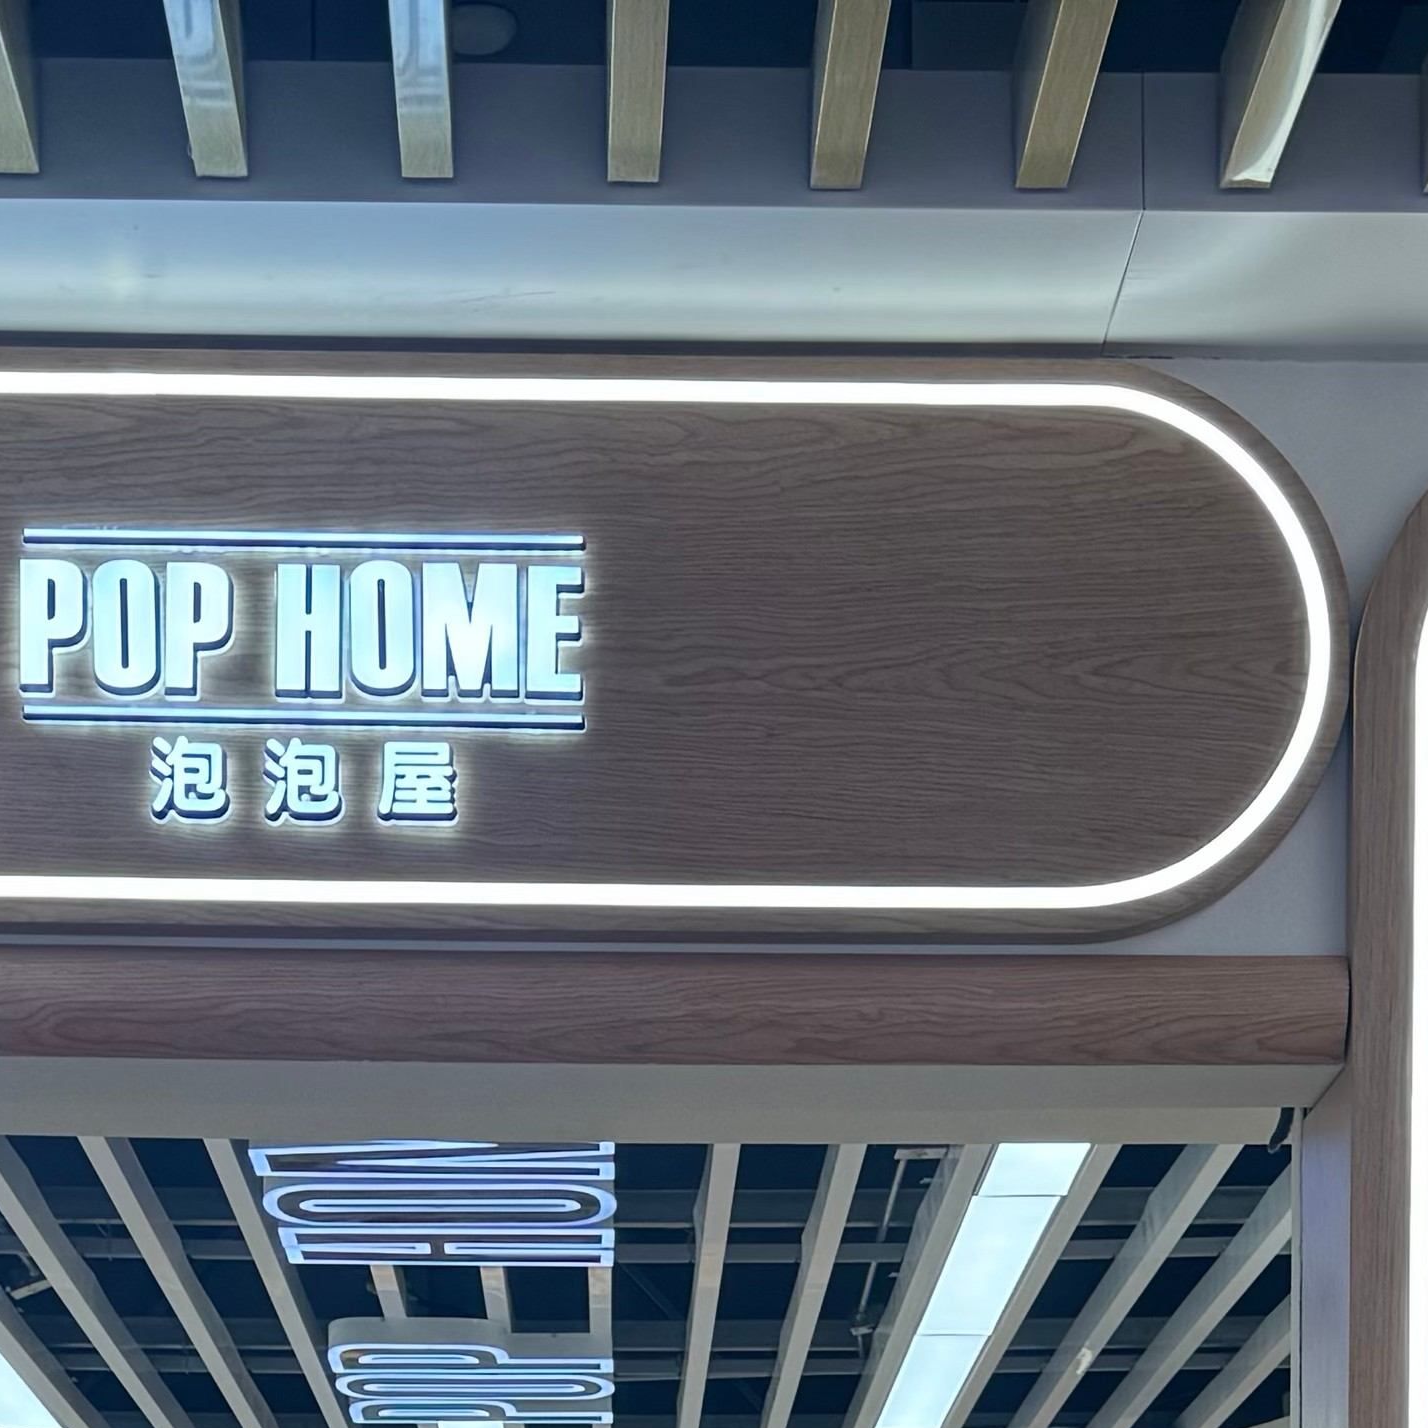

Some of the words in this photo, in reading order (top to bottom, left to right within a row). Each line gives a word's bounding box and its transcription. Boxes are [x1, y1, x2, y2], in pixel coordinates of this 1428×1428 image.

[19, 557, 234, 702] POP
[273, 561, 587, 706] HOME
[149, 736, 459, 827] 泡泡屋
[248, 1140, 617, 1267] HOM
